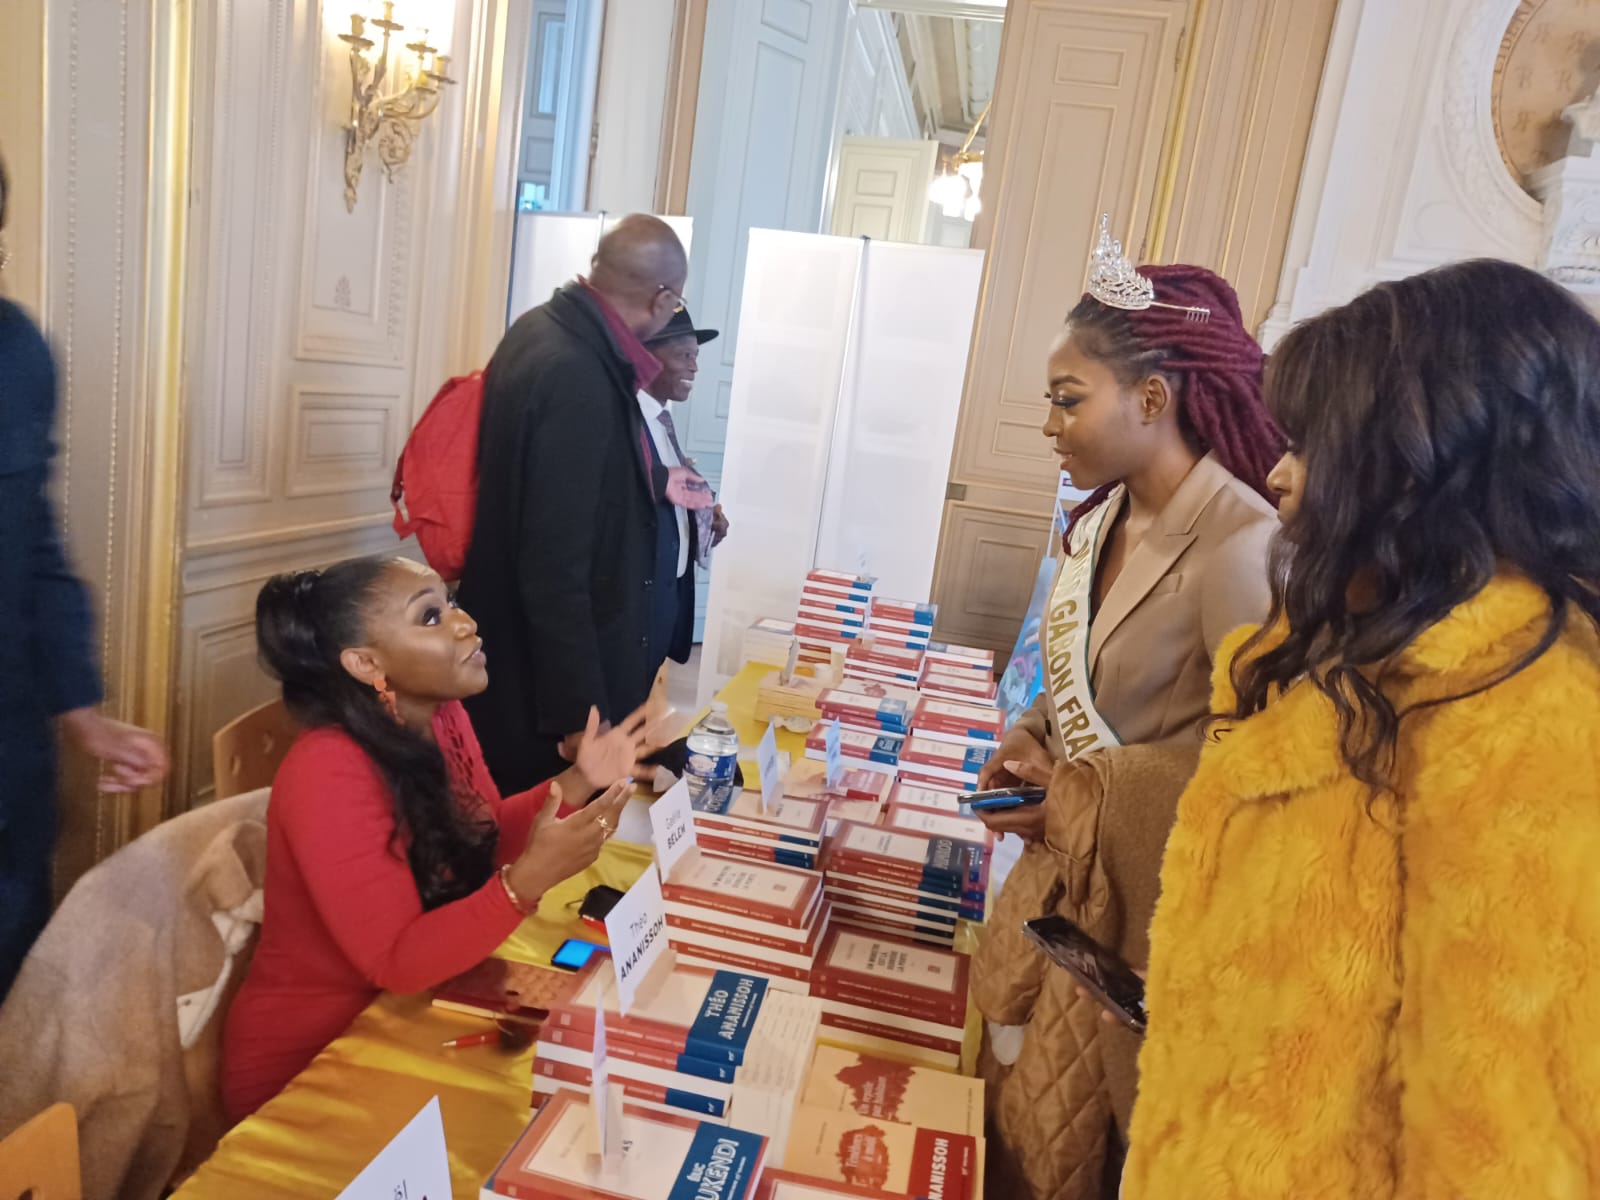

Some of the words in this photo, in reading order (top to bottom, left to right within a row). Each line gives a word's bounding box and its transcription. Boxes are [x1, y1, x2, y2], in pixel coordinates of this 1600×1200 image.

[1048, 599, 1078, 698] GABON
[1057, 695, 1099, 759] FRA
[620, 915, 664, 983] ANANISSOH
[704, 989, 729, 1018] THÉO
[718, 978, 755, 1041] ANANISSOH
[694, 1138, 740, 1200] UKENDI
[927, 1137, 949, 1200] NANISSOH
